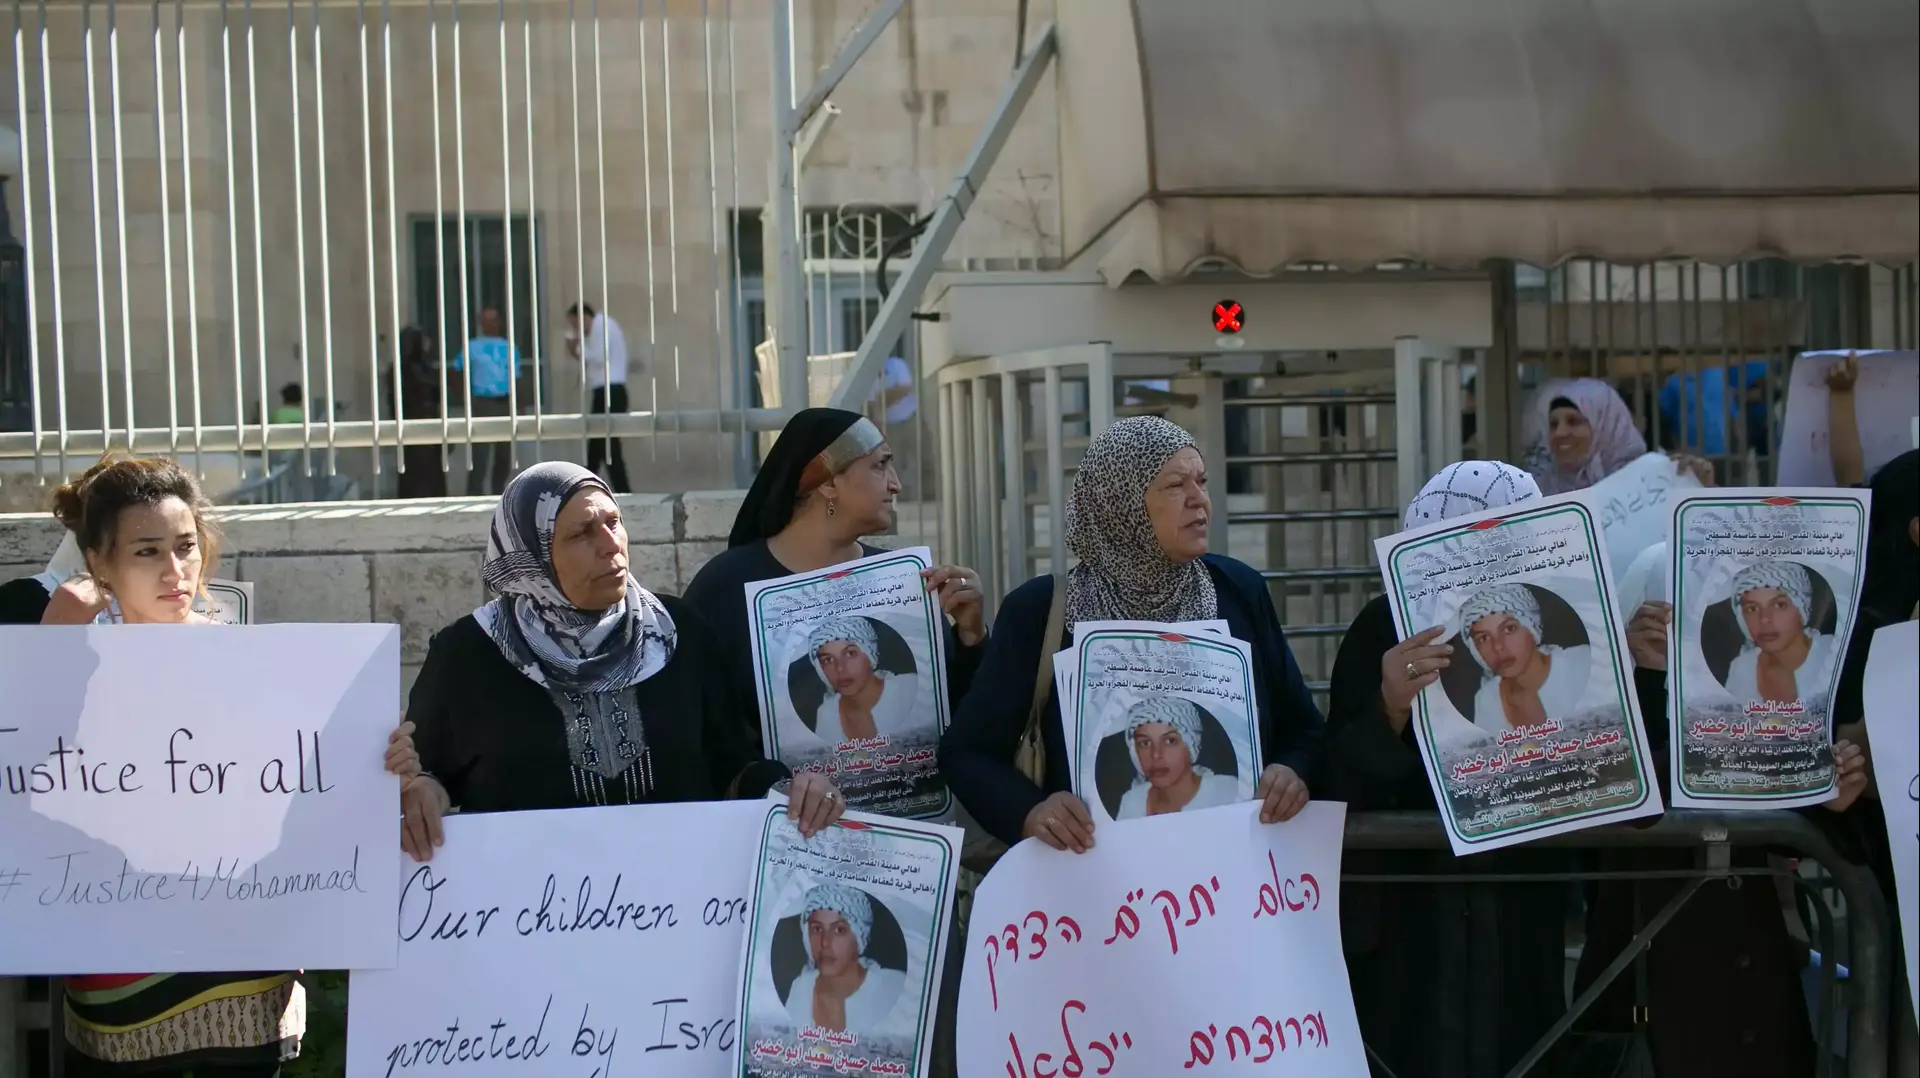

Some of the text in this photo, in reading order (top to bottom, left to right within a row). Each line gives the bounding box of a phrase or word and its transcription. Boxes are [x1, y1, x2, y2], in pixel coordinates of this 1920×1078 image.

[1705, 530, 1731, 542] فلسطين
[1733, 530, 1757, 539] عاصمة
[1790, 530, 1812, 541] القدس
[1812, 530, 1829, 542] مدينة
[1504, 548, 1526, 562] القدس
[1527, 546, 1546, 556] مدينة
[1447, 561, 1472, 572] عاصمة
[1473, 553, 1500, 567] الشريف
[1524, 559, 1547, 573] شعفاط
[1548, 556, 1565, 569] قرية
[1422, 565, 1447, 580] فلسطين
[1474, 572, 1495, 585] يزفون
[1496, 566, 1523, 578] الصامدة
[1436, 581, 1455, 594] الفجر
[1456, 576, 1473, 588] شهيد
[850, 590, 868, 600] القدس
[870, 586, 886, 596] مدينة
[803, 601, 823, 609] عاصمة
[824, 595, 847, 606] الشريف
[866, 598, 885, 608] شعفاط
[886, 595, 902, 607] قرية
[781, 605, 802, 616] فلسطين
[841, 603, 865, 613] الصامدة
[808, 612, 823, 621] شهيد
[1129, 662, 1152, 672] عاصمة
[1202, 669, 1217, 682] مدينة
[1216, 687, 1229, 699] قرية
[1743, 699, 1805, 717] لشهيد البطل
[1496, 718, 1564, 747] الشهيد البطل
[1690, 717, 1729, 740] خضير
[1752, 720, 1788, 740] سعيد
[833, 733, 890, 756] الشهيد البطل
[1584, 730, 1621, 749] محمد
[1546, 738, 1582, 760] حسين
[165, 727, 236, 794] for
[260, 728, 335, 794] all
[874, 752, 905, 771] حسين
[906, 748, 936, 764] محمد
[1510, 746, 1545, 767] سعيد
[843, 757, 874, 775] سعيد
[1451, 753, 1487, 782] خضير
[1511, 775, 1521, 783] الله
[828, 852, 855, 864] الشريف
[856, 858, 880, 867] القدس
[881, 859, 900, 872] مدينة
[872, 875, 893, 886] شعفاط
[895, 878, 912, 891] قرية
[1253, 849, 1321, 920] האם
[398, 865, 499, 941] Our
[516, 873, 678, 937] children
[984, 910, 1082, 1012] הצדק
[384, 994, 552, 1078] protected
[571, 1003, 618, 1078] by
[797, 1024, 859, 1047] الشهيد البطل
[1184, 1010, 1329, 1069] והרוצחים
[751, 1038, 784, 1061] خضير
[803, 1046, 835, 1069] سعيد
[834, 1050, 870, 1075] حسين
[870, 1056, 905, 1076] محمد
